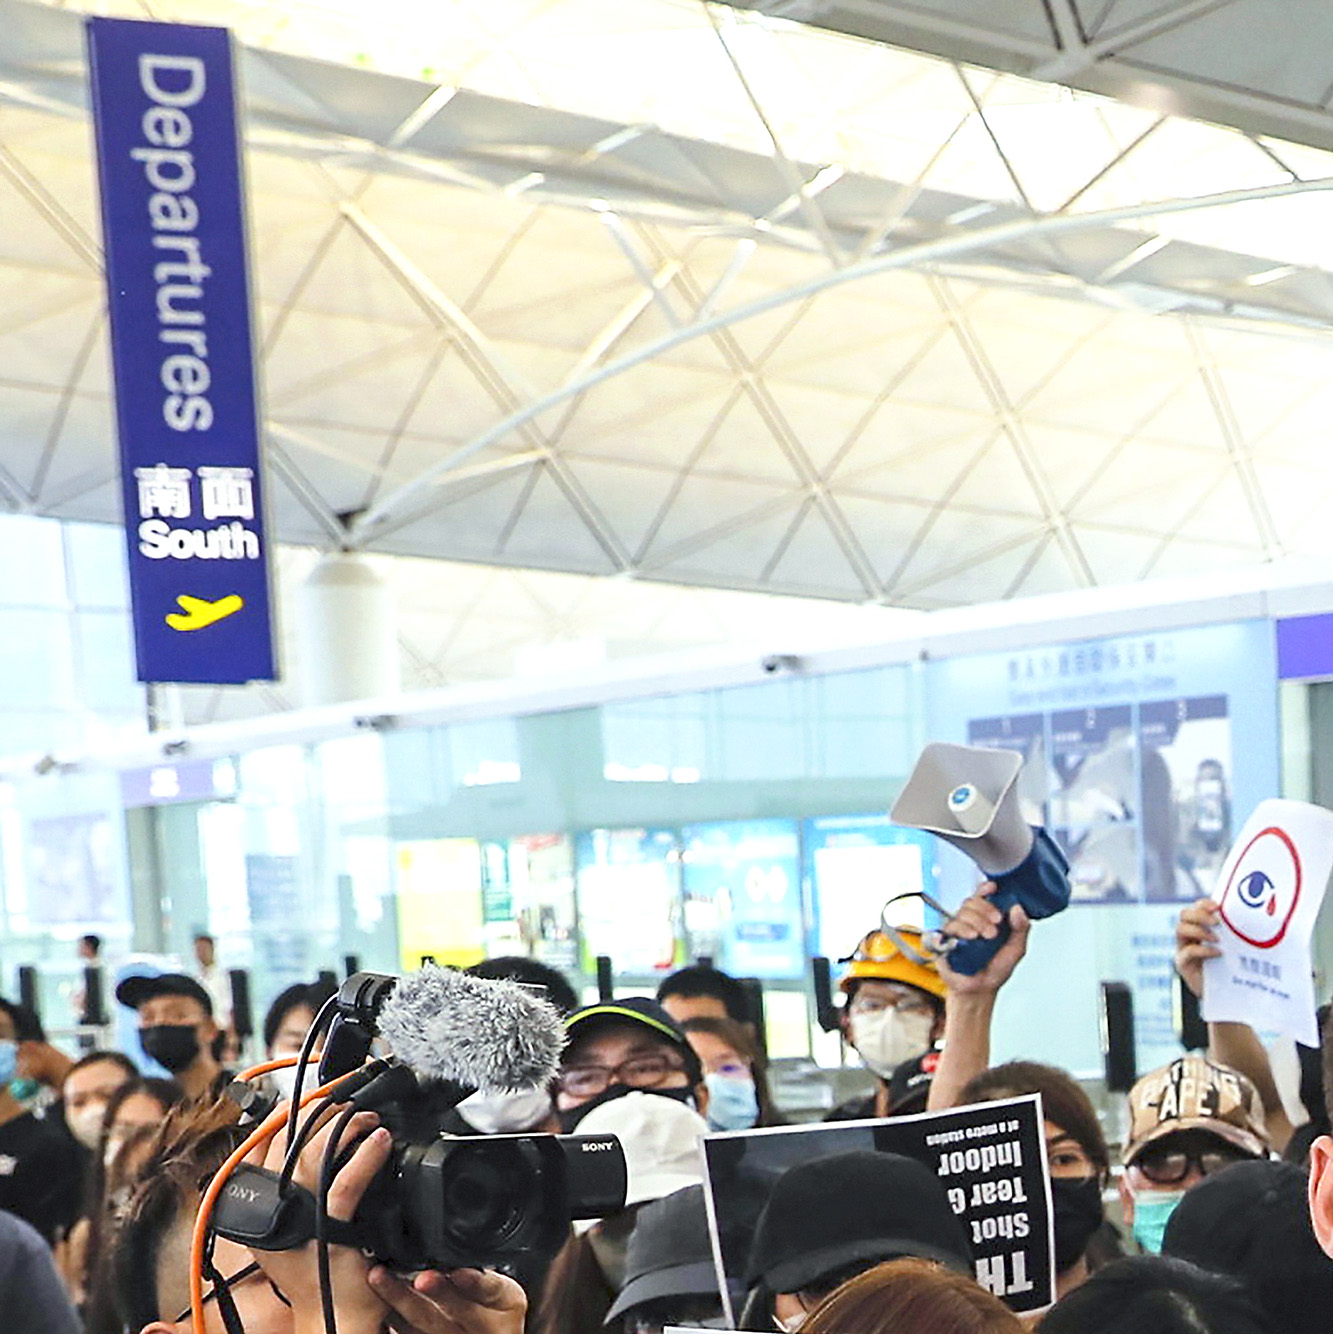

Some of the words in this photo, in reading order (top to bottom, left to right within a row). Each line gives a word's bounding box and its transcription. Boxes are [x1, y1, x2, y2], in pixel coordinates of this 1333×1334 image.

[132, 53, 213, 432] Departures
[134, 463, 254, 520] 南面
[138, 519, 259, 560] South
[581, 1142, 613, 1152] SONY
[938, 1141, 1023, 1176] Indoor
[228, 1184, 260, 1203] ONY
[970, 1177, 1028, 1207] Tear
[971, 1213, 1030, 1243] Shot
[975, 1251, 1034, 1296] TH
